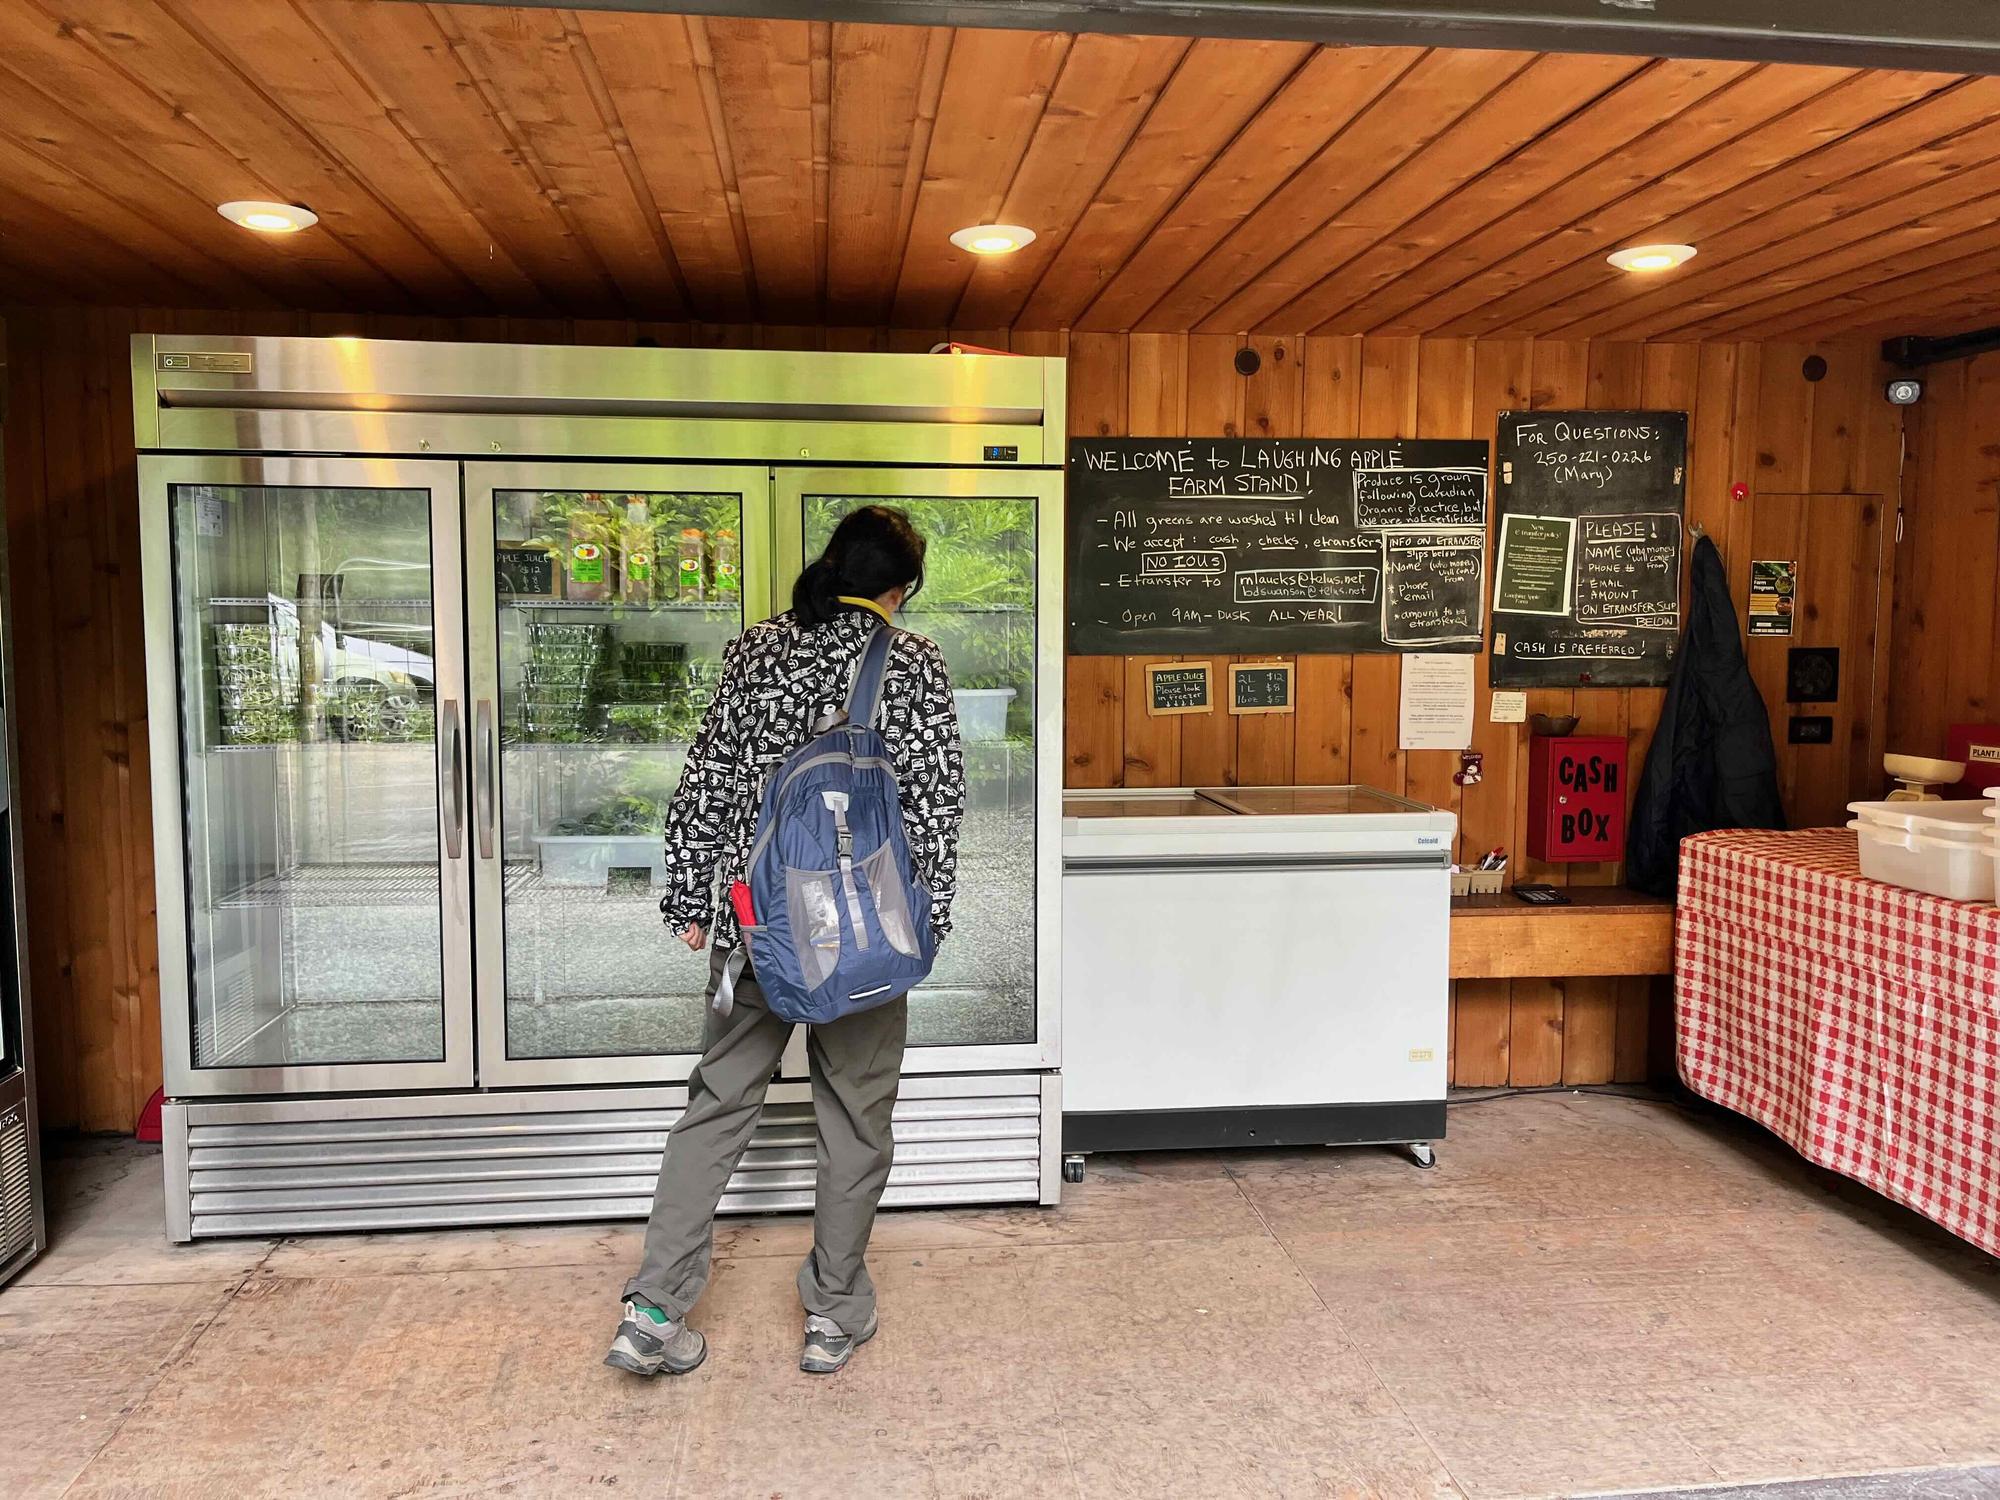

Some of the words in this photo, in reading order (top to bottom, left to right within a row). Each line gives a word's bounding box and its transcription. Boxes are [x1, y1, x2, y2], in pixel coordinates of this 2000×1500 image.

[1084, 448, 1194, 472] WELCOME
[1207, 447, 1229, 470] to
[1241, 445, 1341, 469] LAUGHING
[1351, 449, 1404, 470] APPLE
[1534, 450, 1651, 466] 250-221-0226
[1357, 473, 1404, 489] Produce
[1428, 473, 1471, 493] grown
[1554, 465, 1613, 488] (Mary)
[1168, 476, 1225, 495] FARM
[1420, 485, 1475, 498] Canadian
[1358, 504, 1403, 517] Organic
[1464, 499, 1481, 512] but
[1114, 510, 1136, 530] All
[1146, 516, 1193, 534] greens
[1200, 516, 1222, 525] are
[1228, 511, 1276, 527] washed
[1380, 518, 1402, 526] are
[1406, 513, 1426, 523] not
[1114, 536, 1136, 552] We
[1313, 535, 1383, 548] etransfers
[1390, 537, 1412, 547] INFO
[1417, 537, 1430, 546] ON
[1585, 545, 1622, 559] NAME
[1147, 556, 1167, 569] NO
[1391, 561, 1422, 574] Name
[1588, 564, 1621, 572] PHONE
[1625, 563, 1635, 572] #
[1202, 574, 1221, 588] to
[1590, 579, 1624, 588] EMAIL
[1404, 589, 1434, 601] email
[1591, 590, 1639, 600] AMOUNT
[1401, 609, 1438, 620] amount
[1582, 604, 1598, 615] ON
[1603, 602, 1656, 614] ETRANSFER
[1122, 609, 1156, 627] Open
[1268, 609, 1295, 622] ALL
[1635, 616, 1673, 628] BELOW
[1514, 641, 1545, 654] CASH
[1554, 643, 1566, 653] IS
[1156, 674, 1181, 682] APPLE
[1183, 672, 1205, 680] JUICE
[1155, 685, 1181, 694] Please
[1183, 683, 1200, 692] look
[1972, 748, 1996, 757] PLANT
[1559, 755, 1618, 793] CASH
[1561, 808, 1610, 844] BOX
